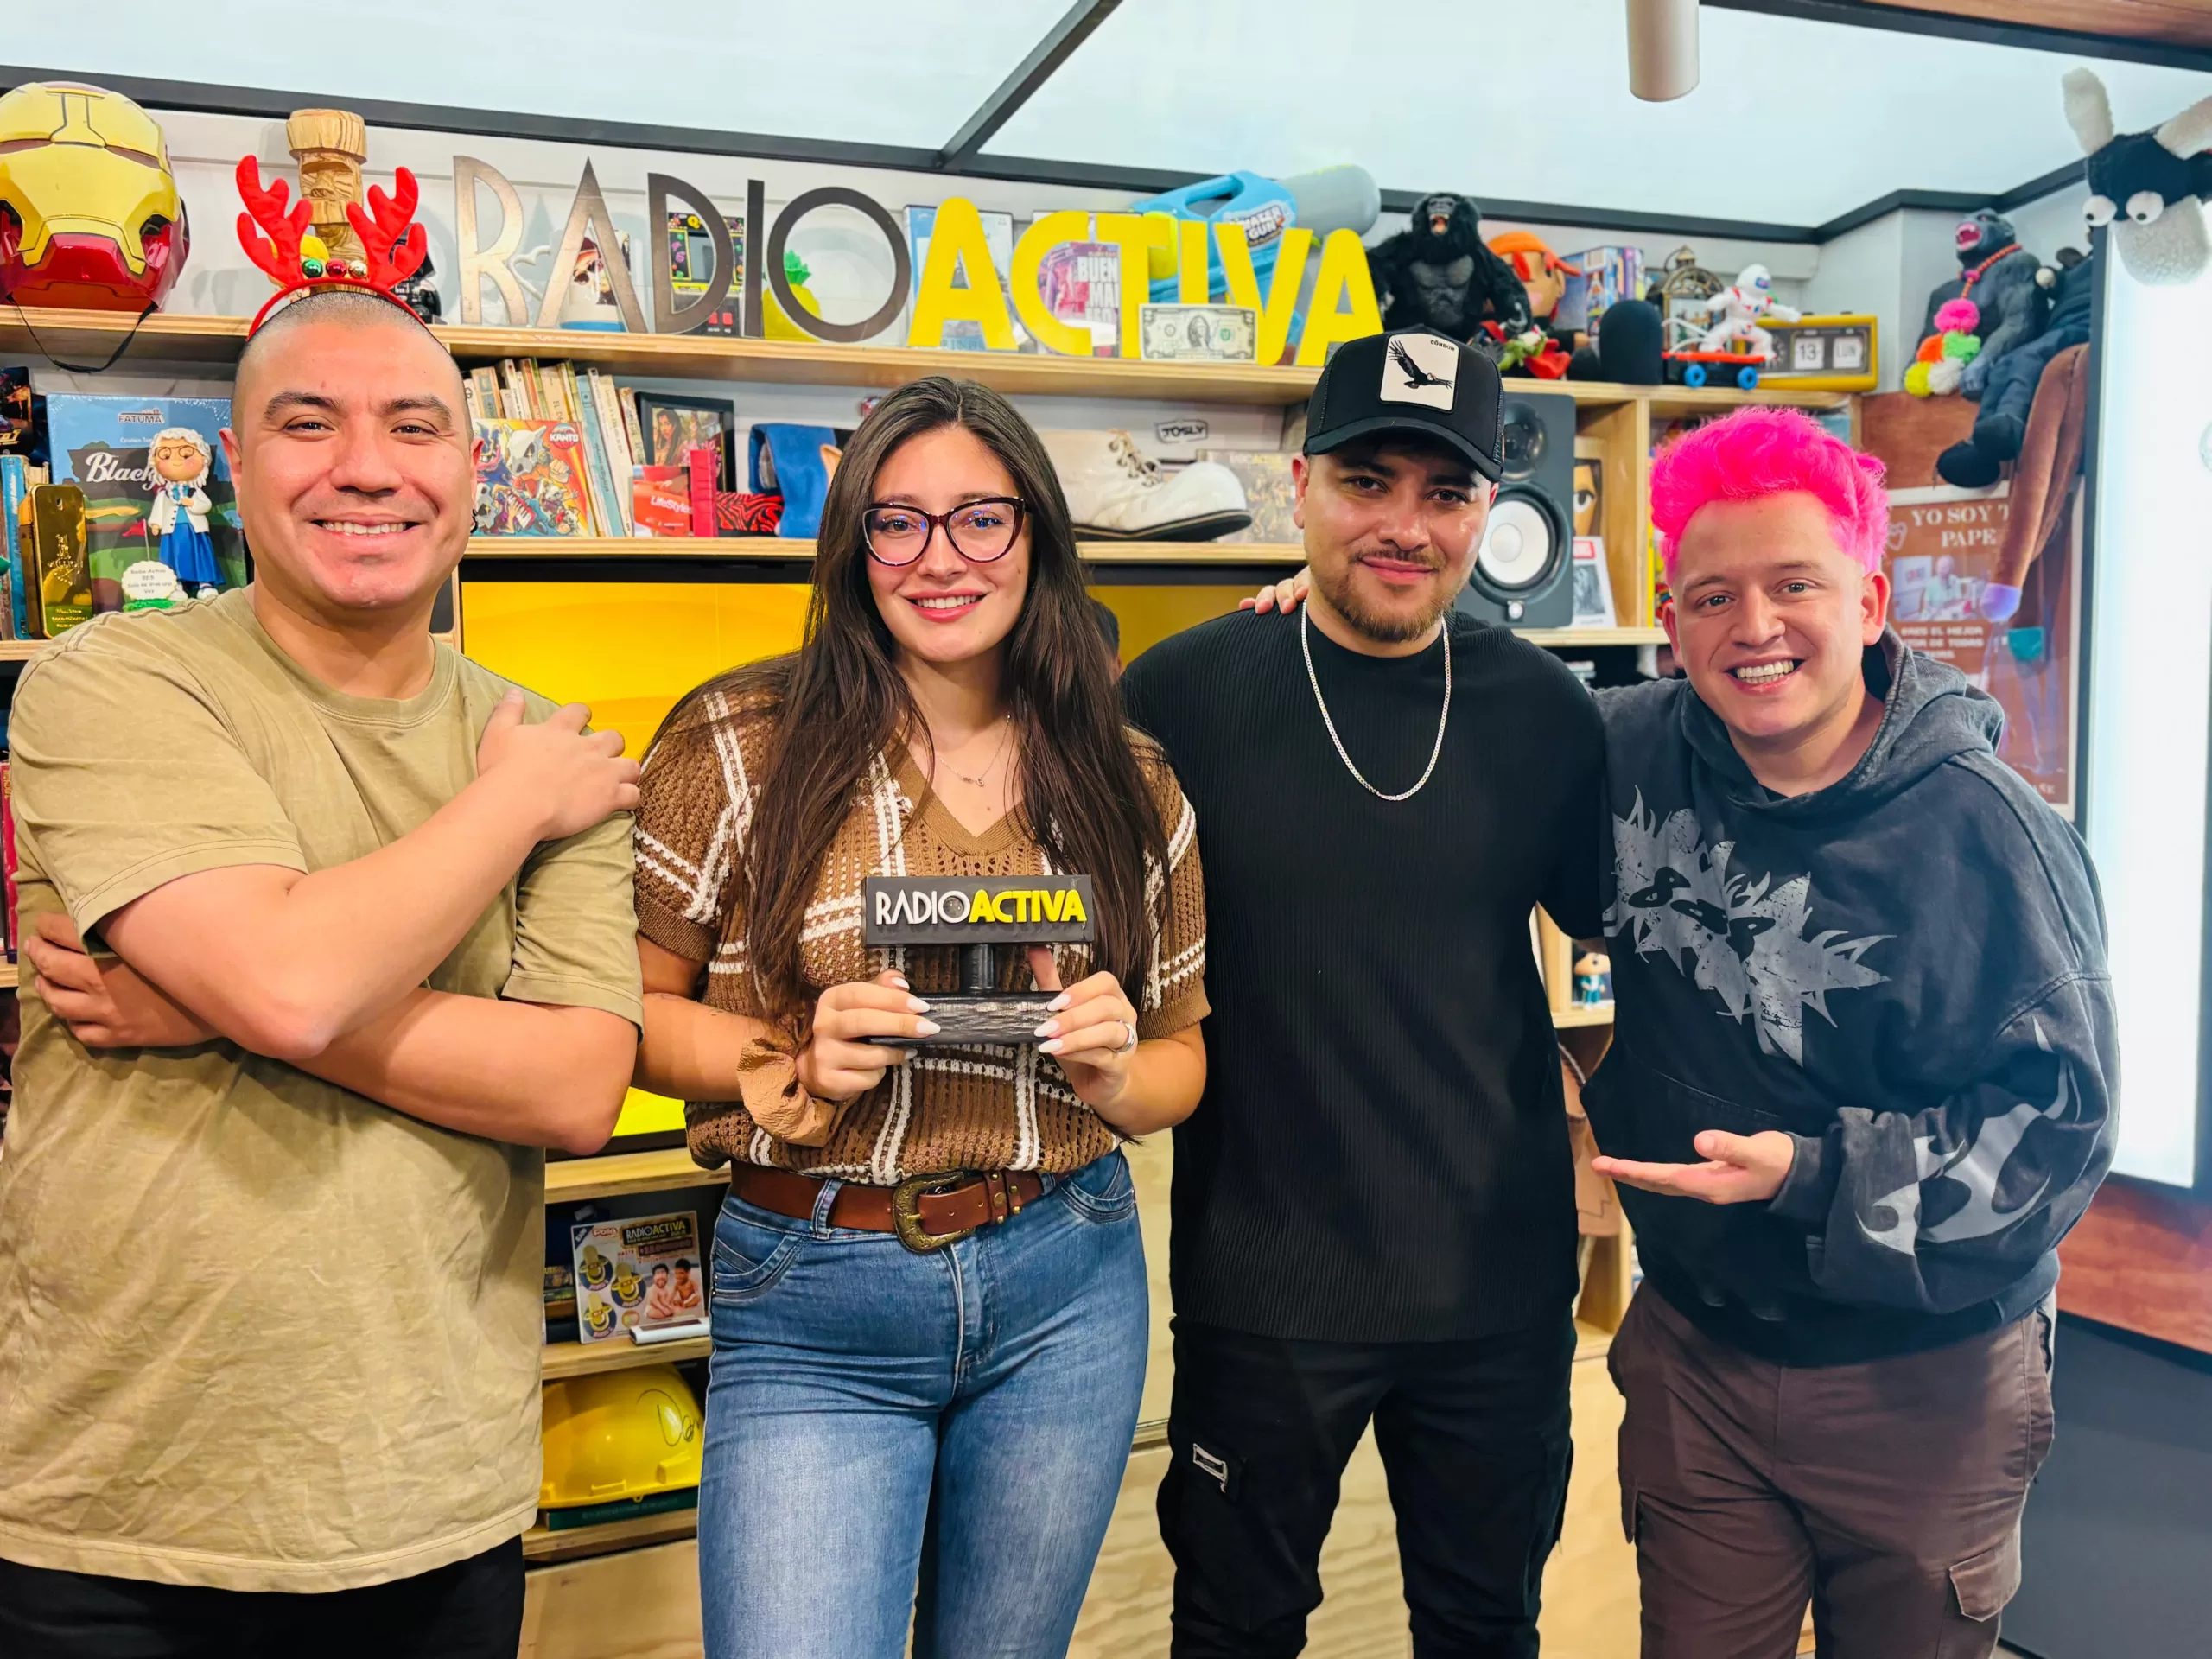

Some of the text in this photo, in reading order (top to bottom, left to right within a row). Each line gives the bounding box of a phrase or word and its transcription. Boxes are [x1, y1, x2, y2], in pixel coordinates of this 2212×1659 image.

[1799, 343, 1816, 360] 13
[118, 415, 163, 423] FATUMA
[550, 433, 579, 444] KANTO
[1910, 508, 1943, 527] YO
[1946, 504, 1993, 524] SOY
[876, 889, 1087, 925] RADIOACTIVA
[626, 1219, 686, 1240] RADIOACTIVA
